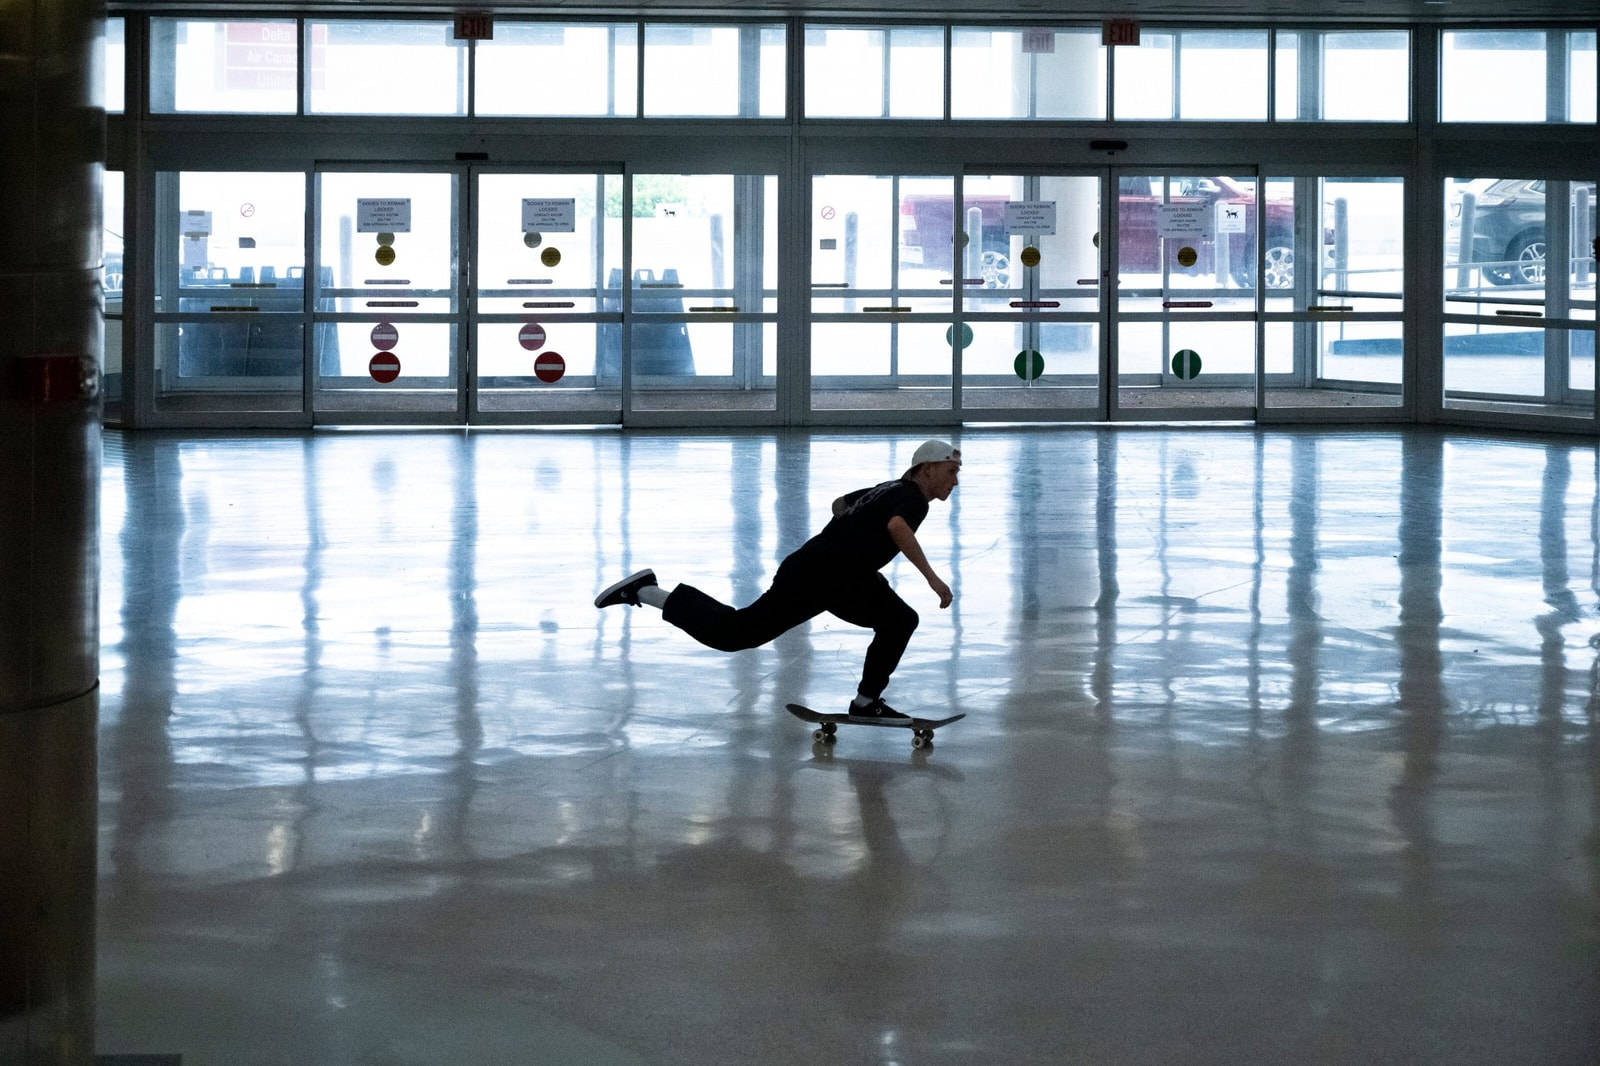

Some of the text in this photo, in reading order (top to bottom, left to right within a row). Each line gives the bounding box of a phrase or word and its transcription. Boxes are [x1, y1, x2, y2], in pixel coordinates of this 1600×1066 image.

[262, 27, 291, 41] Delta
[461, 16, 488, 37] EXIT
[1110, 23, 1135, 43] EXIT
[246, 50, 263, 64] Air
[257, 72, 295, 89] United
